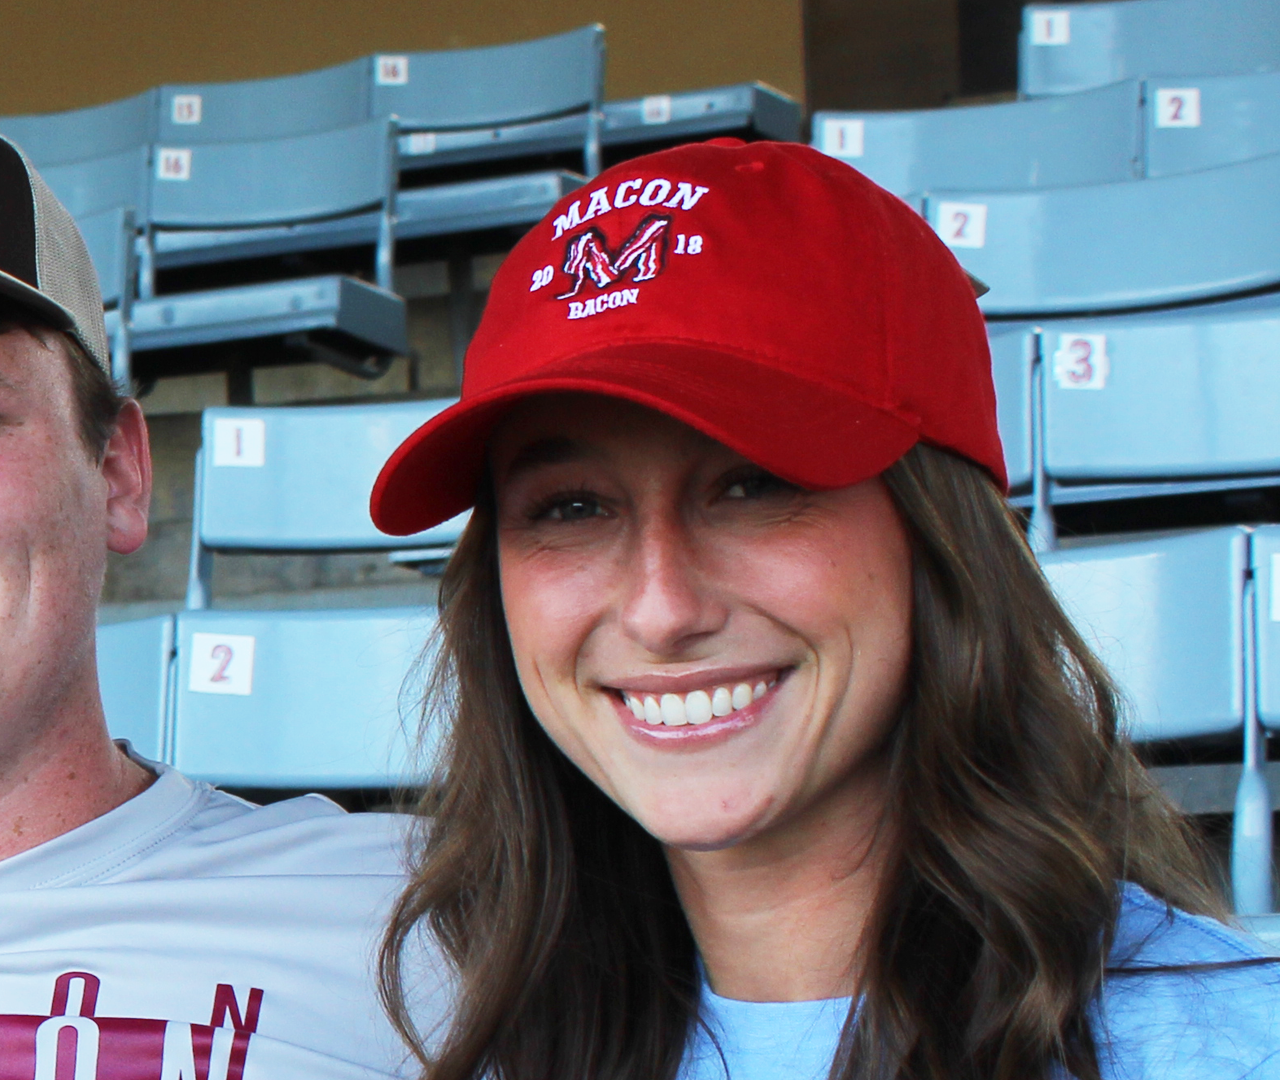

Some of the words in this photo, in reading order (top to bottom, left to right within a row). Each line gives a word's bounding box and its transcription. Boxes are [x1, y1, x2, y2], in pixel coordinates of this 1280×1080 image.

[383, 64, 400, 79] 16
[1170, 96, 1184, 120] 2
[164, 157, 183, 174] 16
[551, 178, 709, 241] MACON
[953, 212, 969, 238] 2
[529, 265, 554, 292] 20
[556, 213, 672, 299] M
[674, 234, 703, 254] 18
[567, 288, 640, 319] BACON
[1069, 341, 1095, 382] 3
[235, 428, 242, 457] 1
[210, 645, 233, 682] 2
